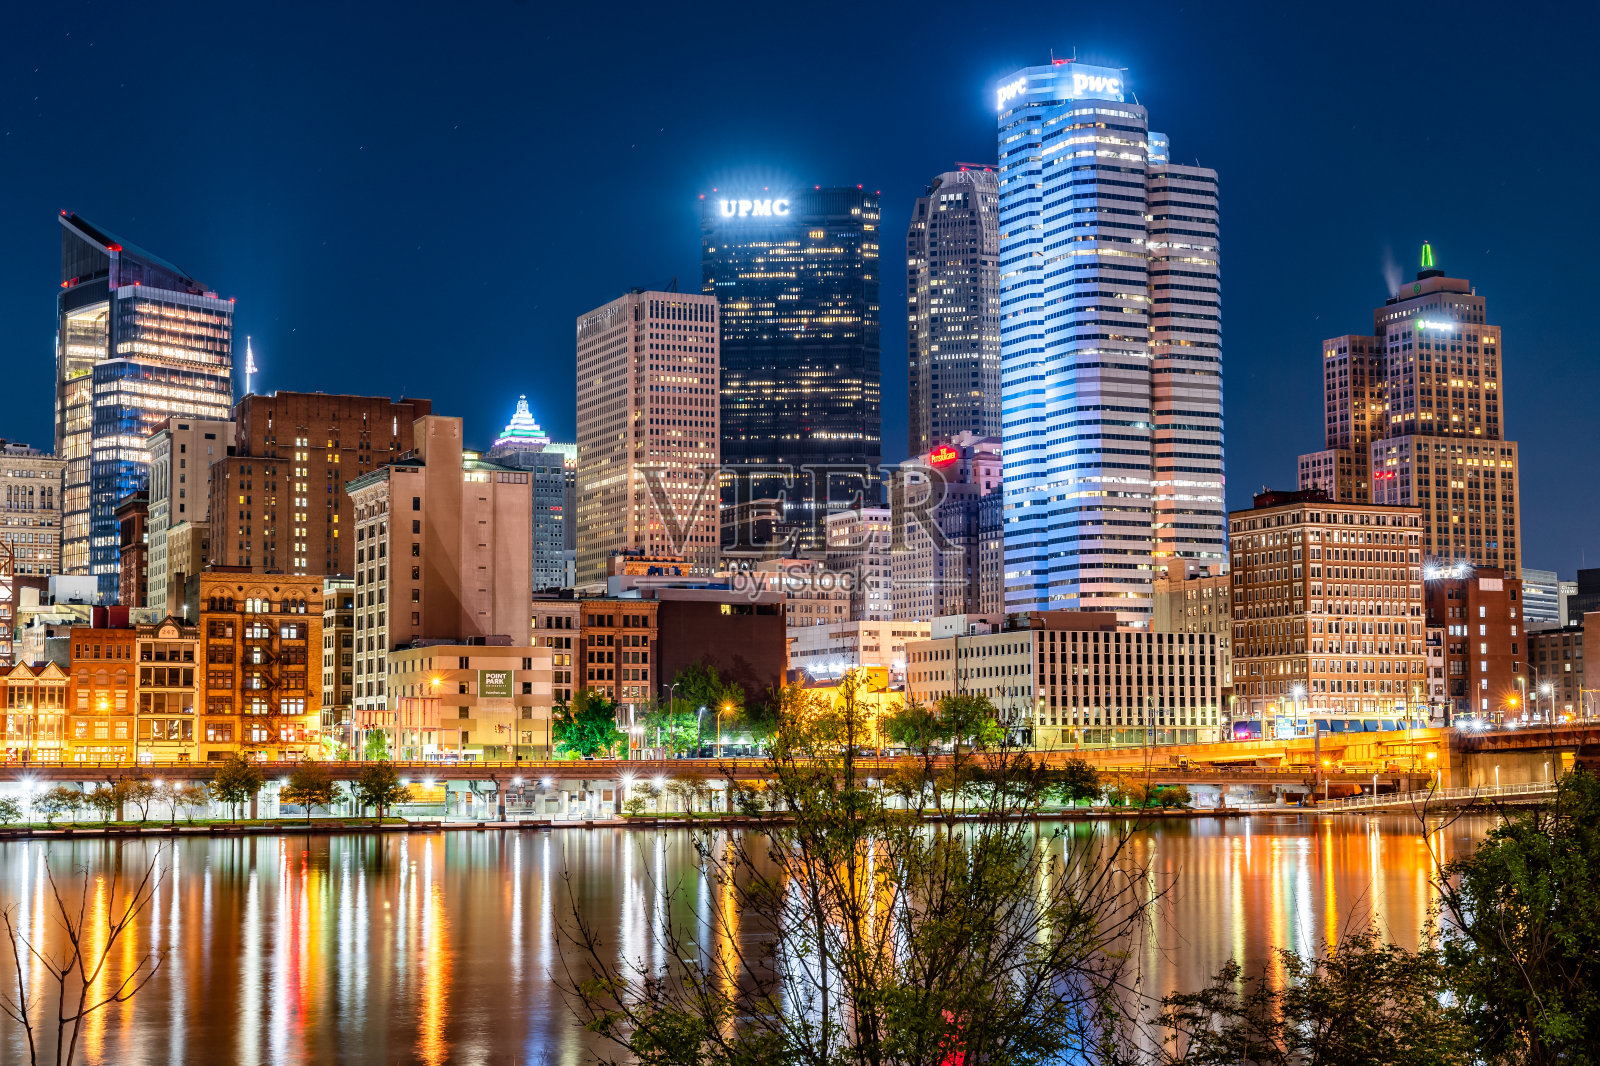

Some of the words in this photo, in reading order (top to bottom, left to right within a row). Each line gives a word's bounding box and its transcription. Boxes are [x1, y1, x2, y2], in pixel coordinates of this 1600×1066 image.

[997, 78, 1027, 110] pwc
[1072, 73, 1120, 96] pwc
[719, 199, 790, 217] UPMC
